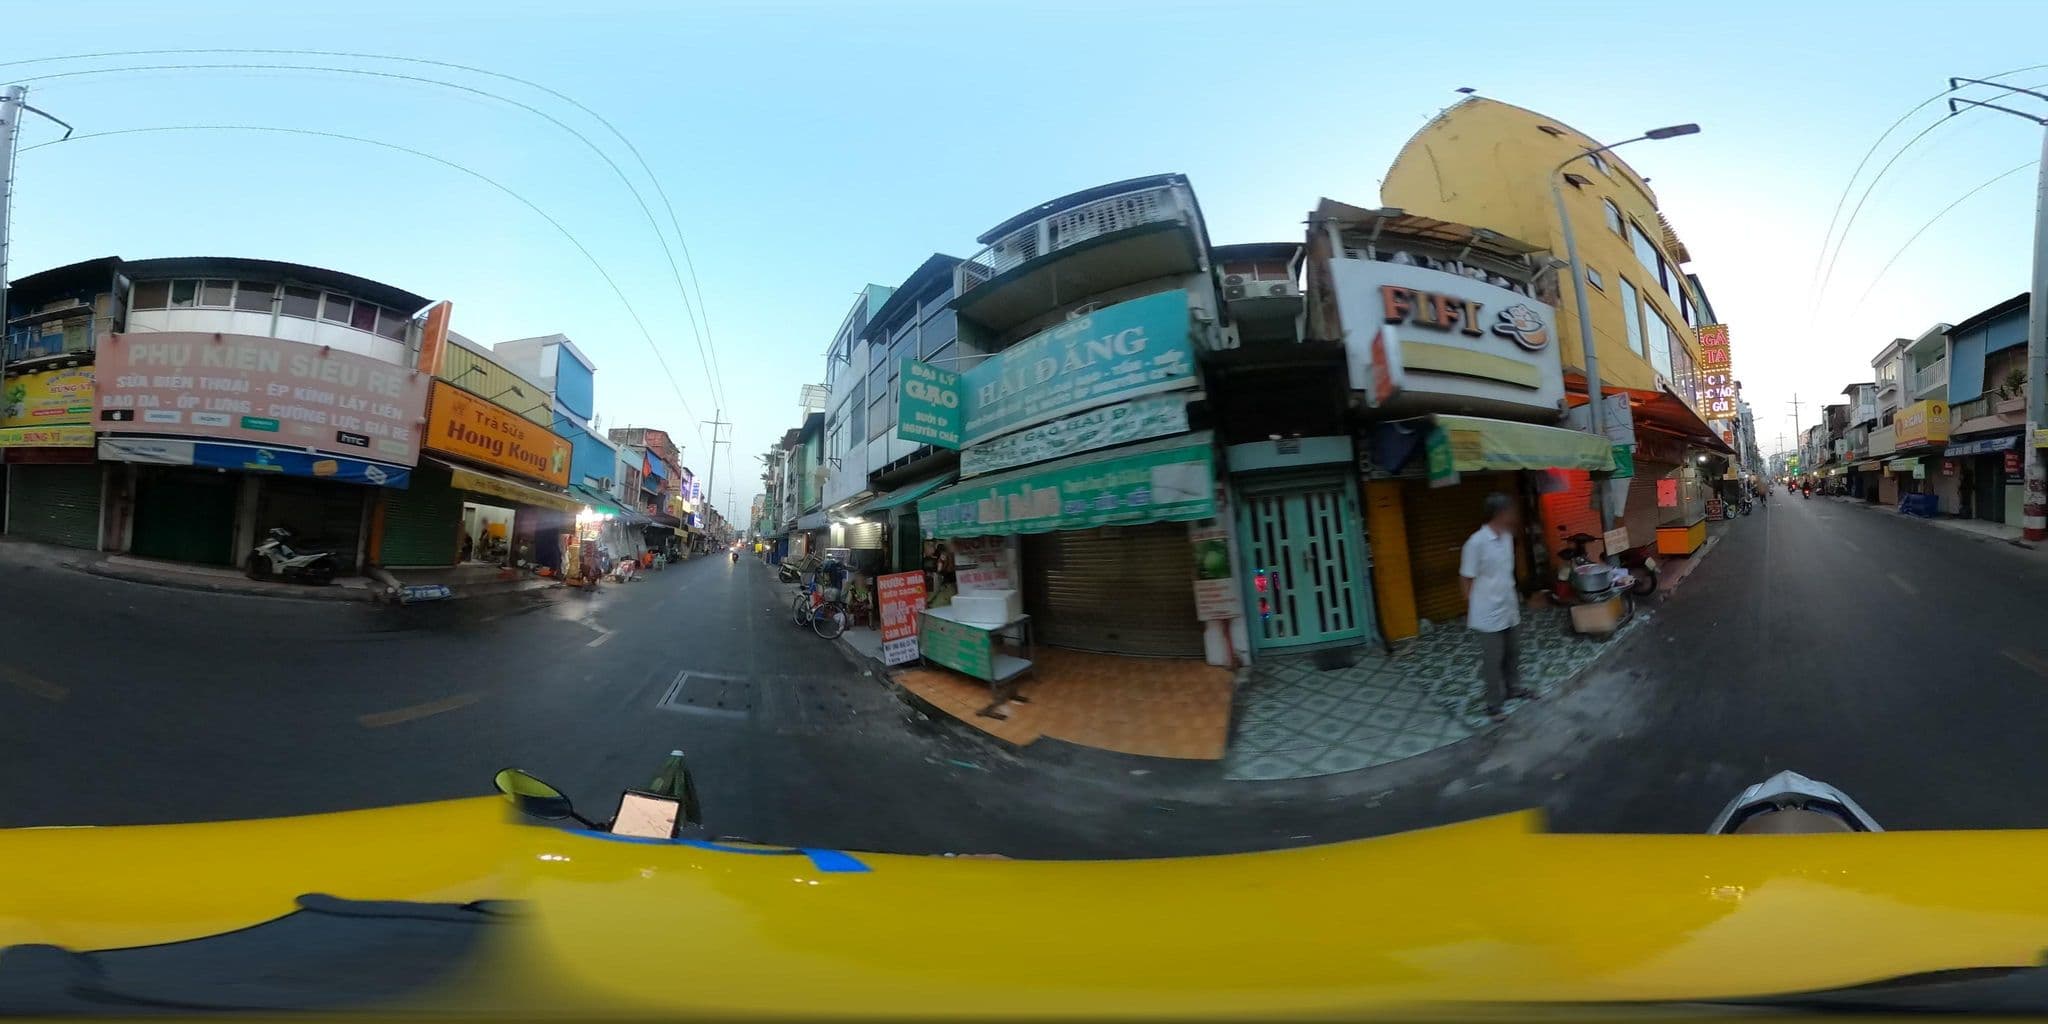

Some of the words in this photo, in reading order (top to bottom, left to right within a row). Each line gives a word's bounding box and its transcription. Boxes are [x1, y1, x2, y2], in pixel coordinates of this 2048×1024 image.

[1379, 284, 1485, 337] FIFI
[1703, 330, 1727, 347] GÀ
[127, 343, 193, 375] PHỤ
[202, 344, 278, 379] KIỆN
[1706, 349, 1728, 364] TA
[905, 379, 959, 409] GẠO
[475, 409, 499, 431] Trà
[447, 418, 505, 457] Hong
[507, 438, 548, 472] Kong
